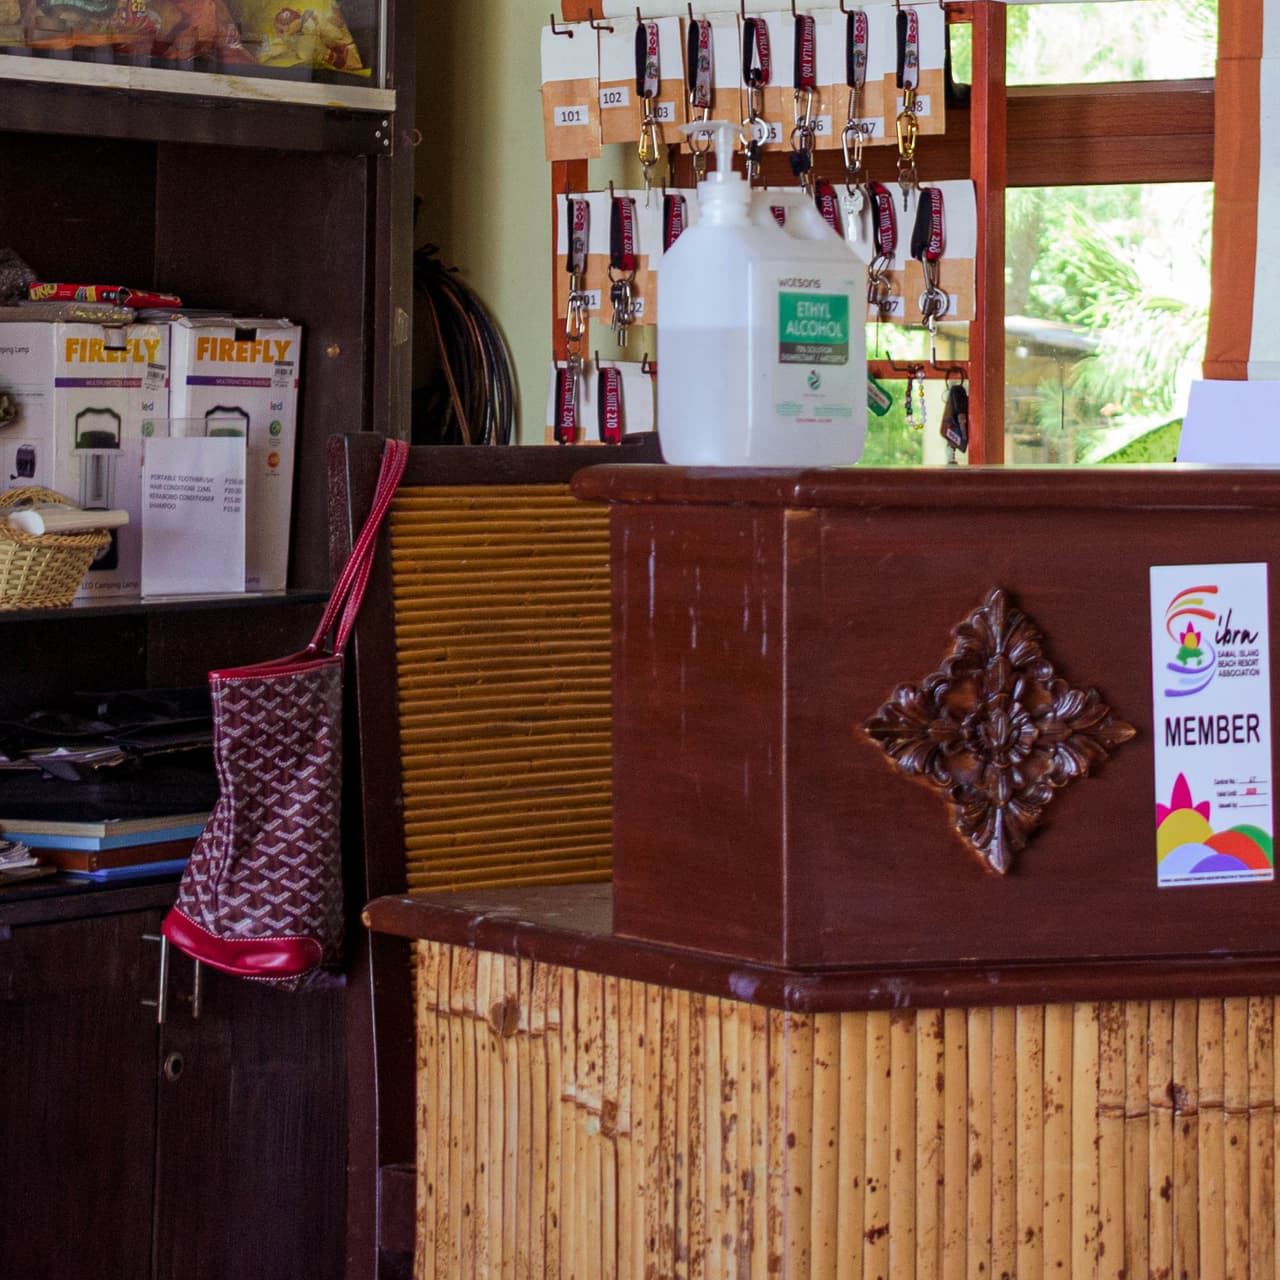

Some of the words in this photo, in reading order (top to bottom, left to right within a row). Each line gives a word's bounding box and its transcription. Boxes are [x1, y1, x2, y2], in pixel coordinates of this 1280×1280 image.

[804, 43, 814, 61] VILLA
[603, 92, 621, 104] 102
[561, 111, 580, 122] 101
[931, 188, 942, 211] HOTEL
[880, 208, 893, 232] SUITE
[931, 211, 942, 234] SUITE
[623, 219, 632, 240] SUITE
[624, 241, 632, 255] 202
[29, 283, 58, 301] UNO
[778, 278, 822, 289] watsons
[796, 301, 831, 319] ETHYL
[786, 320, 843, 338] ALCOHOL
[196, 336, 292, 363] FIREFLY
[141, 401, 154, 411] led
[270, 401, 283, 411] led
[607, 391, 617, 411] SUITE
[149, 503, 177, 511] SHAMPOO
[1165, 713, 1261, 747] MEMBER
